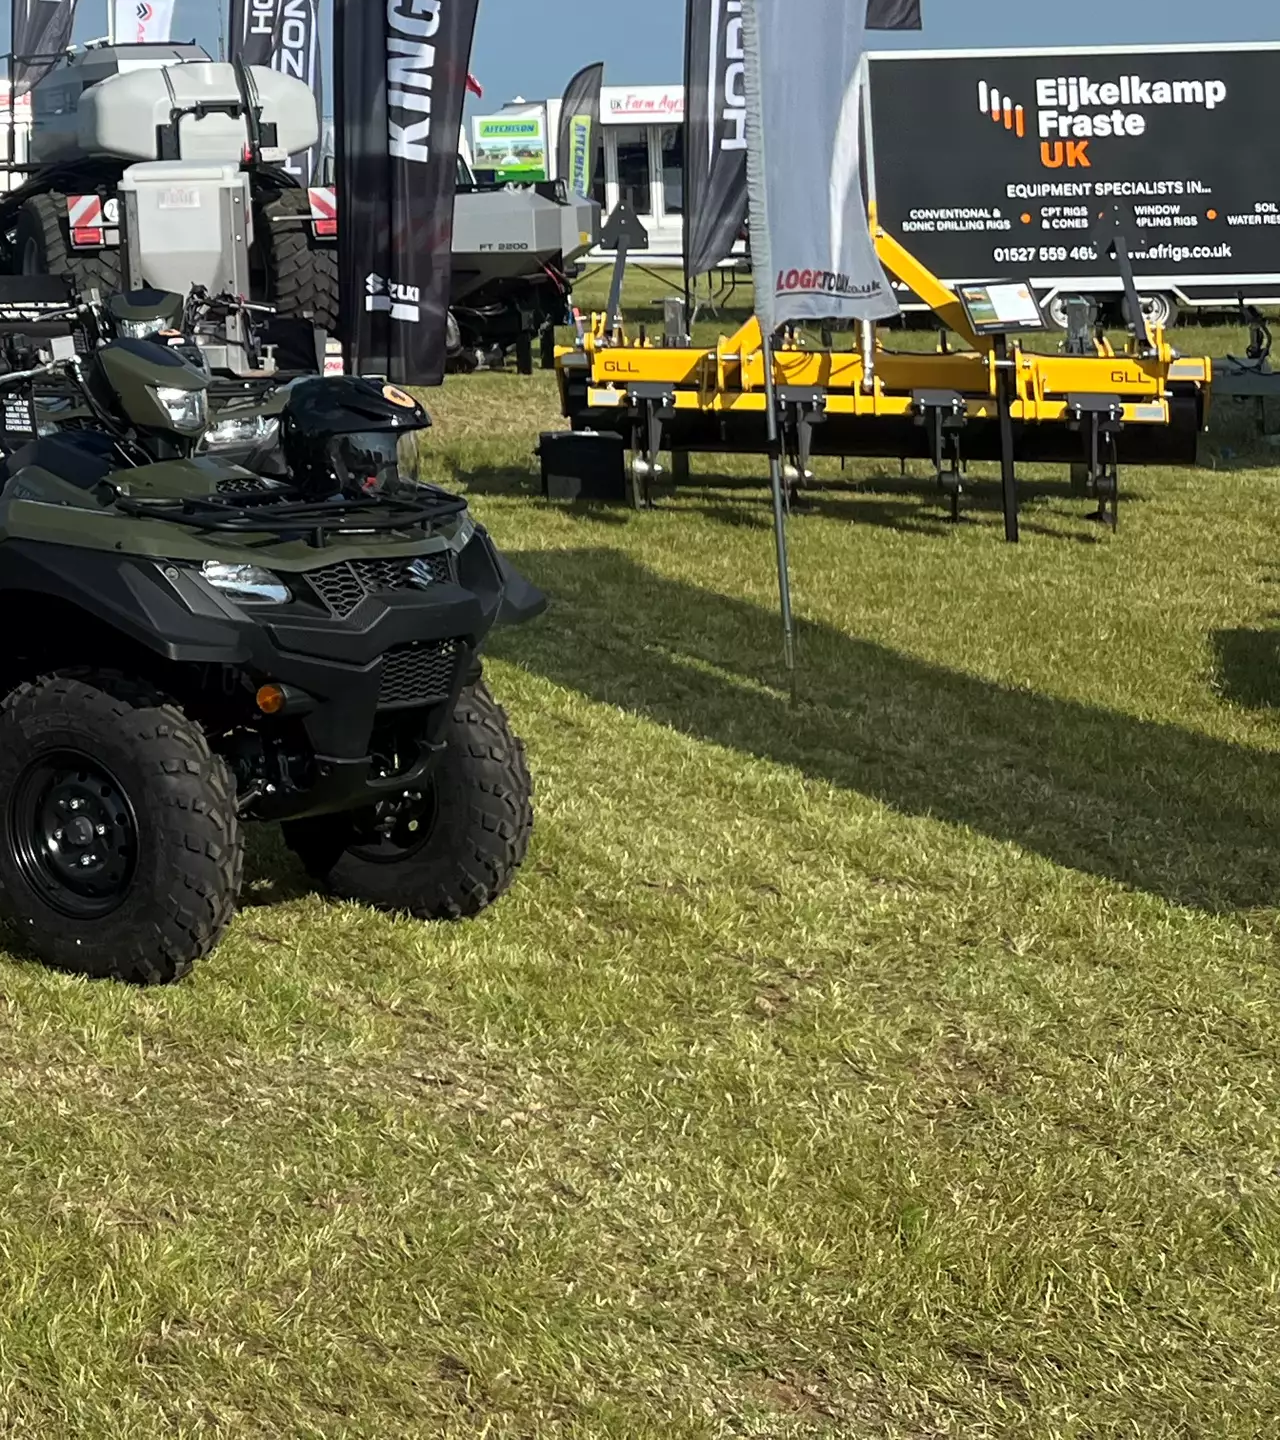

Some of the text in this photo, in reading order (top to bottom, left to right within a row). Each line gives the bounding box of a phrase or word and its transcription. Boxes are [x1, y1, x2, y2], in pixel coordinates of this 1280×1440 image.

[1036, 76, 1227, 112] Eijkelkamp
[483, 124, 535, 134] AITCHISON
[1038, 109, 1146, 138] Fraste
[1040, 140, 1091, 168] UK
[1007, 180, 1212, 198] EQUIPMENT SPECIALISTS IN...
[910, 208, 991, 220] CONVENTIONAL
[1041, 206, 1088, 217] CPT RIGS
[1134, 205, 1180, 215] WINDOW
[1254, 203, 1279, 213] SOIL
[902, 219, 1011, 232] SONIC DRILLING RIGS
[1052, 218, 1088, 229] CONES
[1174, 216, 1198, 227] RIGS
[1227, 215, 1262, 225] WATER
[498, 243, 529, 251] 2200
[993, 247, 1036, 261] 01527
[1039, 247, 1067, 261] 559
[603, 359, 640, 373] GLL
[1110, 370, 1150, 384] GLL
